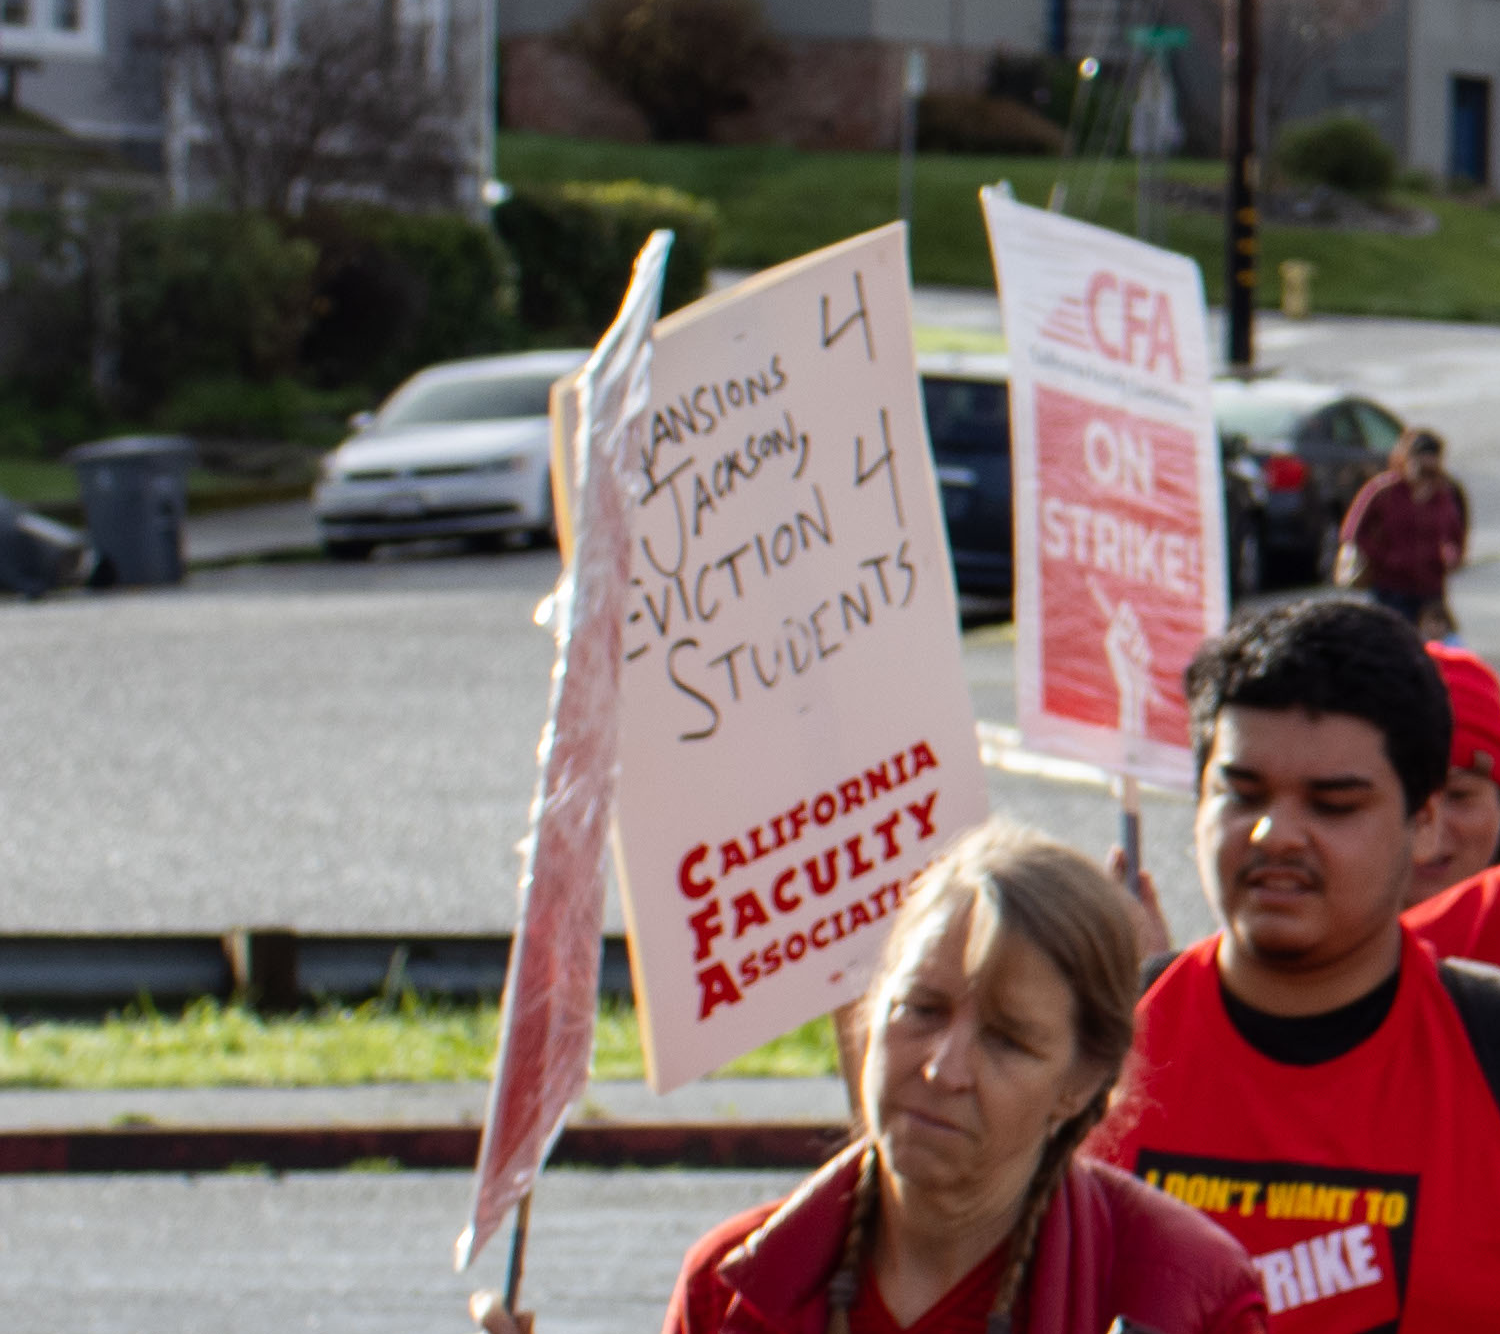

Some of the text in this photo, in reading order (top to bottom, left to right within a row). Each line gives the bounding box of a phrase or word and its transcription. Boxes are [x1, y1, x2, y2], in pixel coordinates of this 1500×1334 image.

[819, 270, 877, 361] 4
[1083, 270, 1185, 385] CFA
[854, 406, 906, 528] 4
[1084, 419, 1153, 497] ON
[1042, 496, 1201, 595] STRIKE!
[666, 539, 917, 743] STUDENTS
[676, 738, 940, 900] CALIFORNIA
[688, 788, 940, 963] FACULTY
[696, 870, 922, 1022] ASSOCIATI
[1265, 1181, 1360, 1224] WANT
[1363, 1190, 1408, 1228] TO
[1252, 1222, 1384, 1315] RIKE
